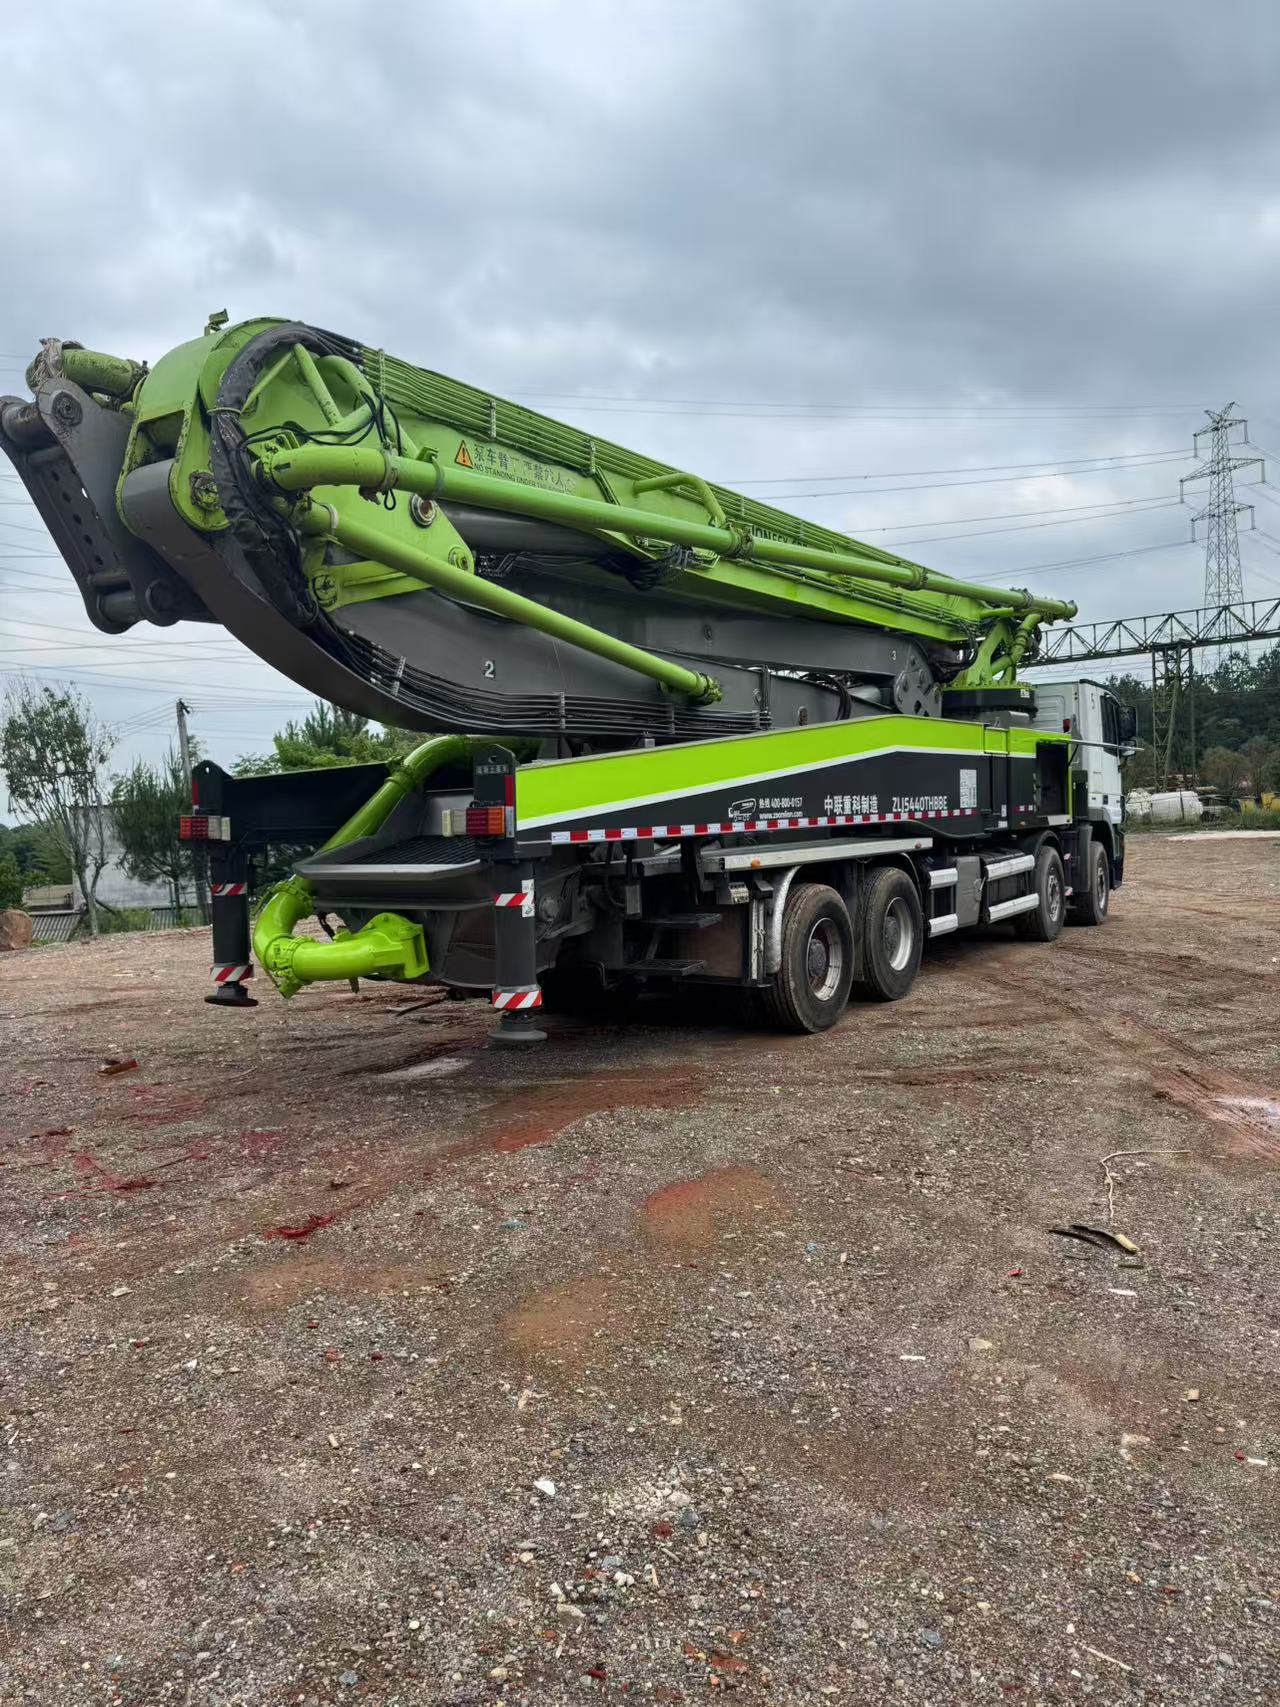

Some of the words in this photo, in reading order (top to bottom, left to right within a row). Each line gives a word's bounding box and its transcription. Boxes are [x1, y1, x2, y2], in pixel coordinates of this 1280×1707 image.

[485, 466, 516, 482] STANDING
[484, 660, 494, 678] 2
[771, 797, 803, 809] 400-800-0157
[824, 794, 879, 816] 中联重科制造
[892, 796, 948, 813] ZLJ5440THBBE
